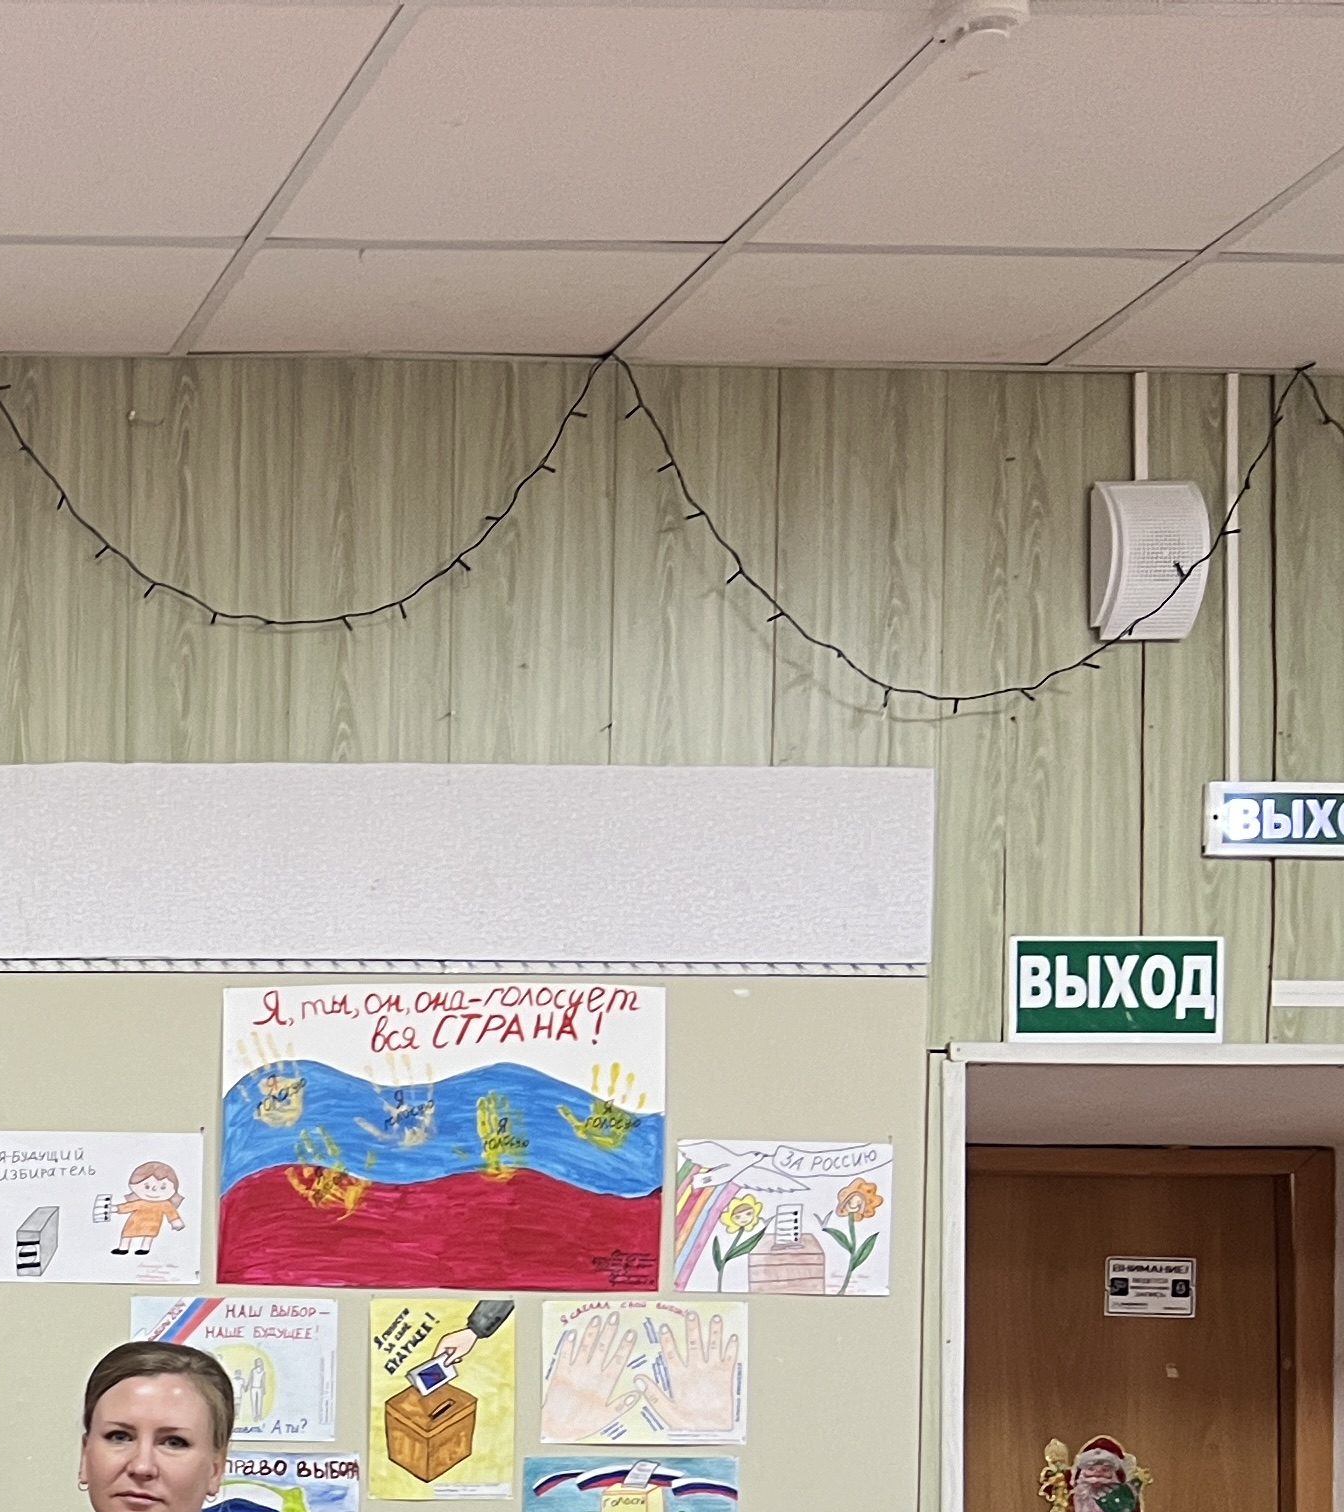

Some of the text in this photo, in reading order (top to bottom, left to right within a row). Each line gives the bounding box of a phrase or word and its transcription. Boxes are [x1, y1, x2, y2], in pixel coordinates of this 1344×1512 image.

[1227, 798, 1344, 841] ВЫХ
[1018, 954, 1215, 1020] ВЫХОД
[252, 990, 295, 1027] Я,
[779, 1149, 878, 1171] ЗА РОССИЮ
[224, 1304, 263, 1319] НАШ
[205, 1326, 245, 1339] НАШЕ
